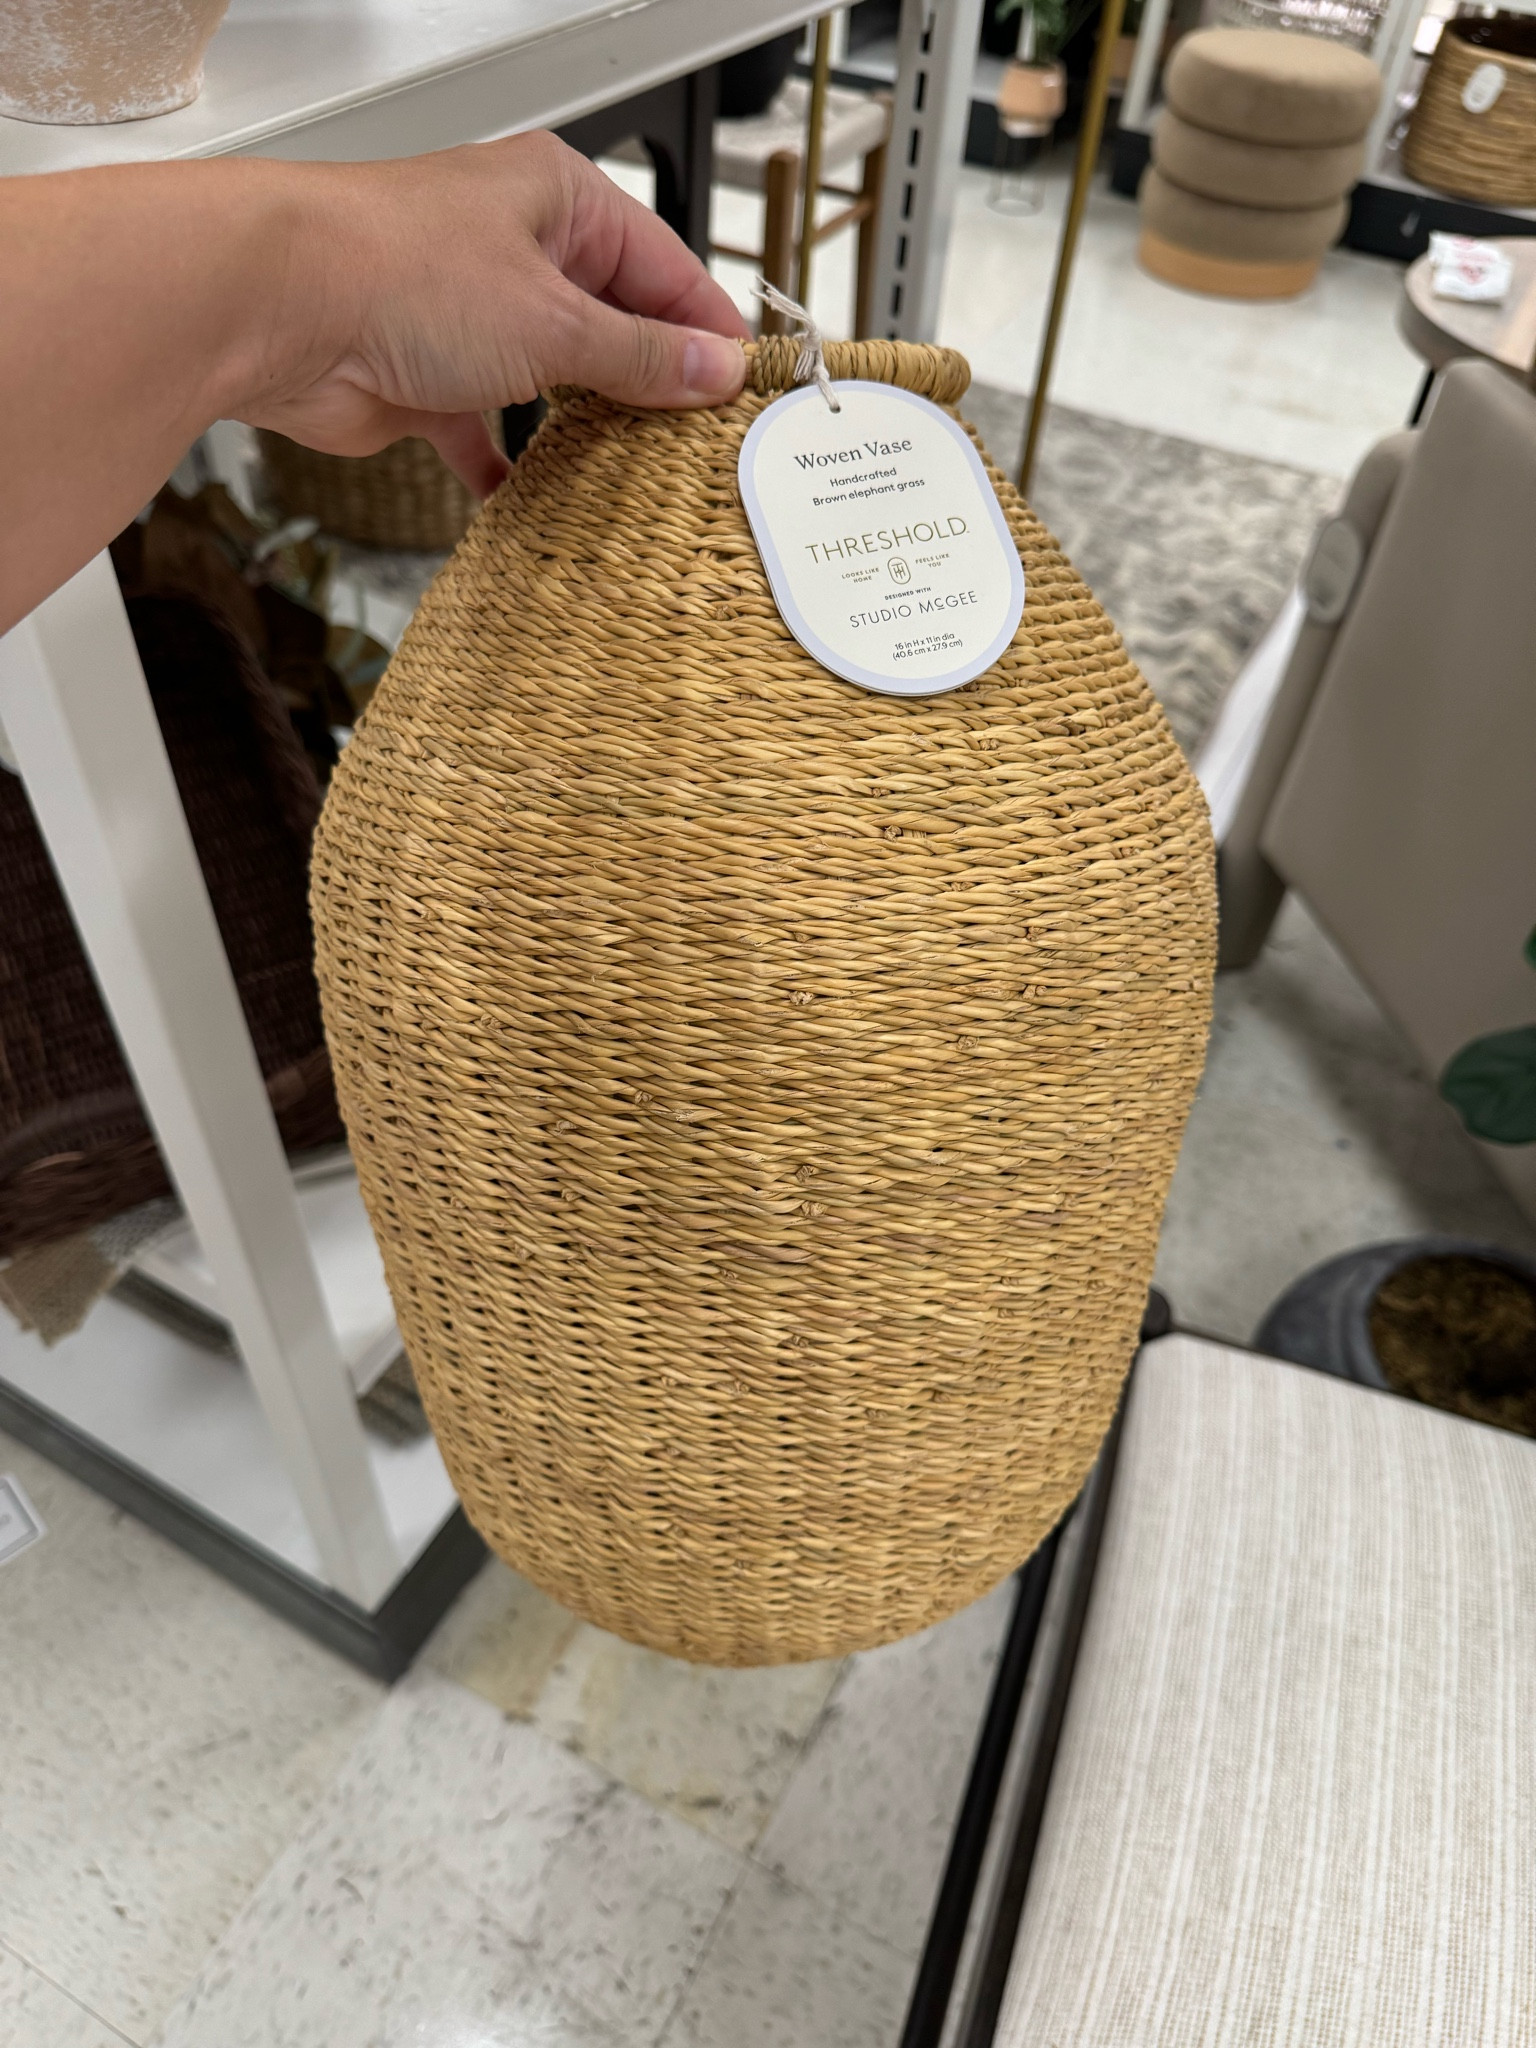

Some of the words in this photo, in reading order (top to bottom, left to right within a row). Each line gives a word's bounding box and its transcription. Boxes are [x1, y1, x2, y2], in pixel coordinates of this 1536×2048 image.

[794, 448, 863, 470] Woven
[864, 438, 913, 457] Vase
[830, 467, 897, 487] Handcrafted
[812, 493, 847, 506] Brown
[848, 484, 896, 501] elephant
[897, 478, 925, 492] grass
[805, 517, 967, 563] THRESHOLD
[915, 556, 934, 564] FEELS
[935, 553, 950, 561] LIKE
[841, 570, 863, 580] LOOKS
[864, 567, 880, 575] LIKE
[853, 575, 872, 583] HOME
[884, 591, 914, 600] DESIGNED
[850, 605, 912, 628] STUDIO
[892, 650, 913, 661] (40.6
[932, 642, 948, 651] 27.9
[949, 639, 963, 648] cm)
[894, 643, 904, 651] 16
[913, 639, 920, 647] H
[926, 636, 933, 644] 11
[942, 632, 955, 640] dia
